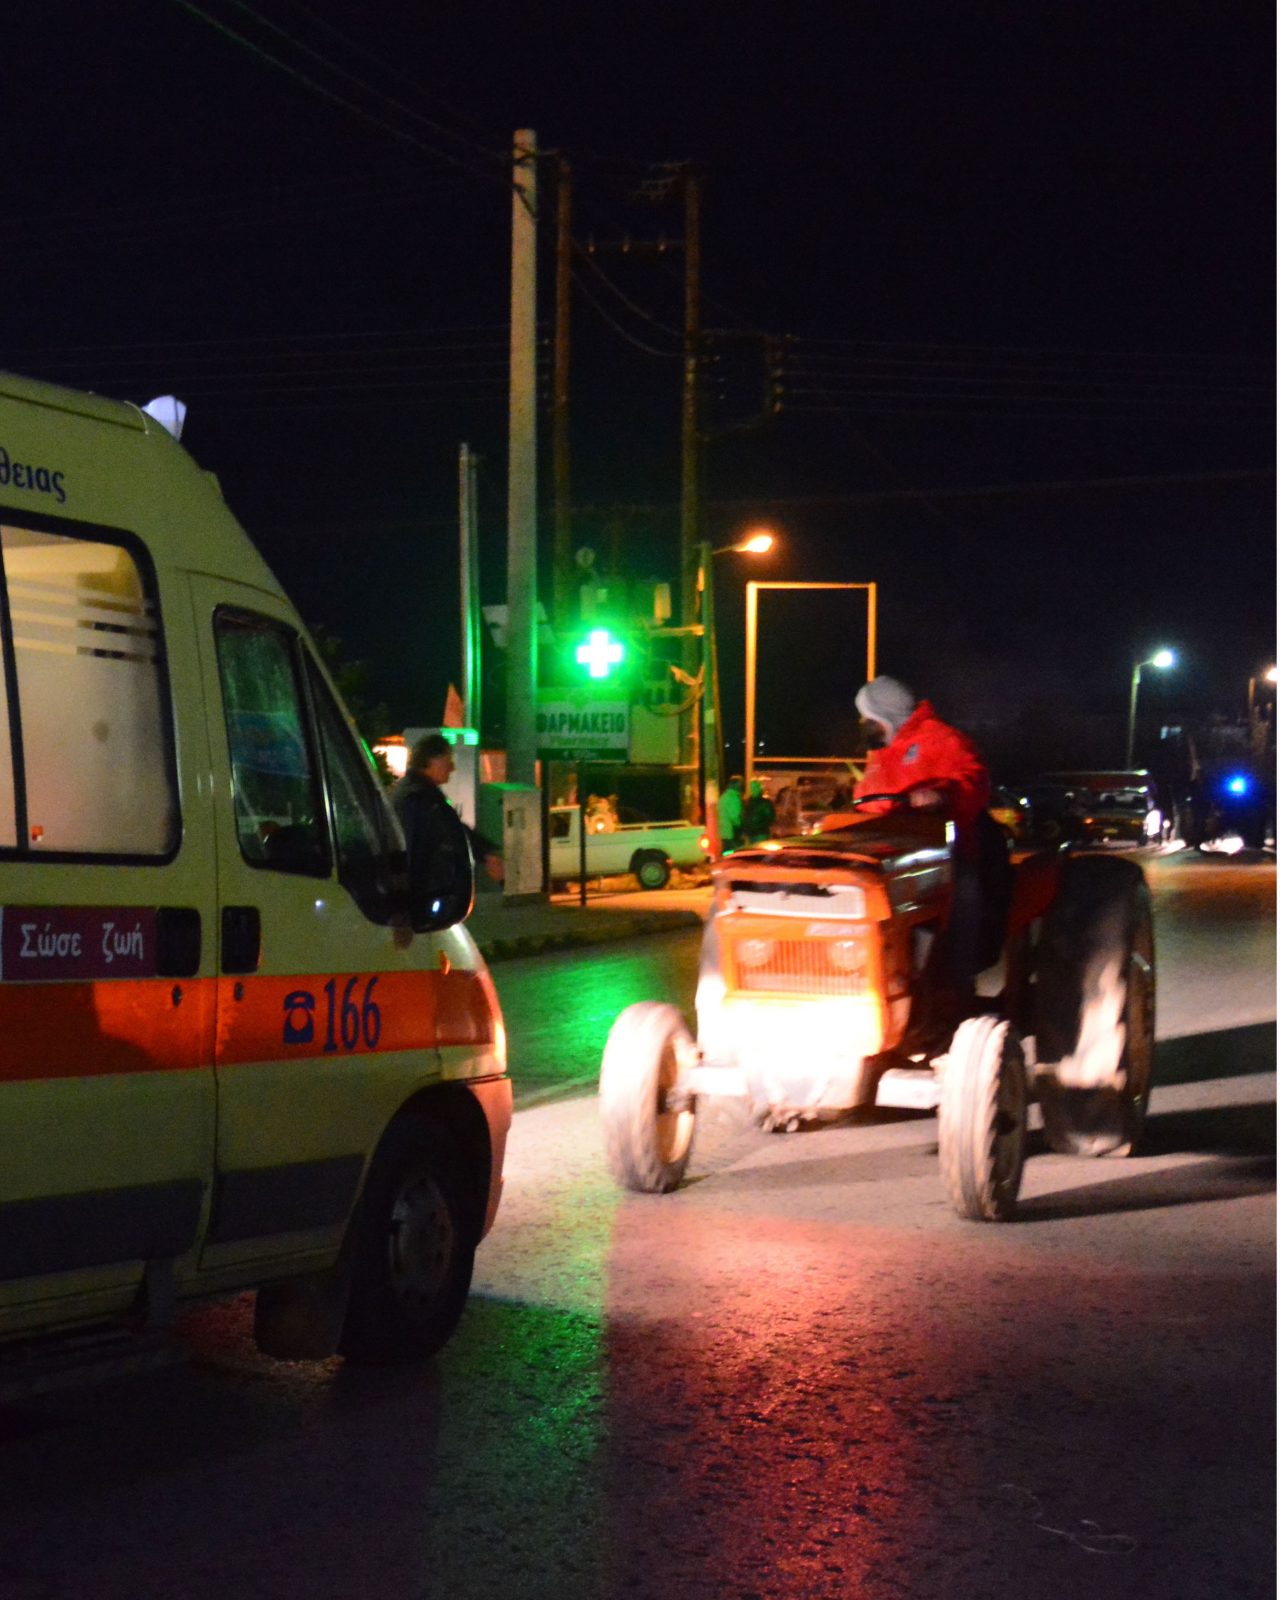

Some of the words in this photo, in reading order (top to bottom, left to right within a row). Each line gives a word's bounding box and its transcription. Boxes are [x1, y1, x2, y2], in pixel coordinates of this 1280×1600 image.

[20, 923, 82, 958] Σώσε
[101, 922, 144, 963] ζωή
[323, 976, 381, 1052] 166
